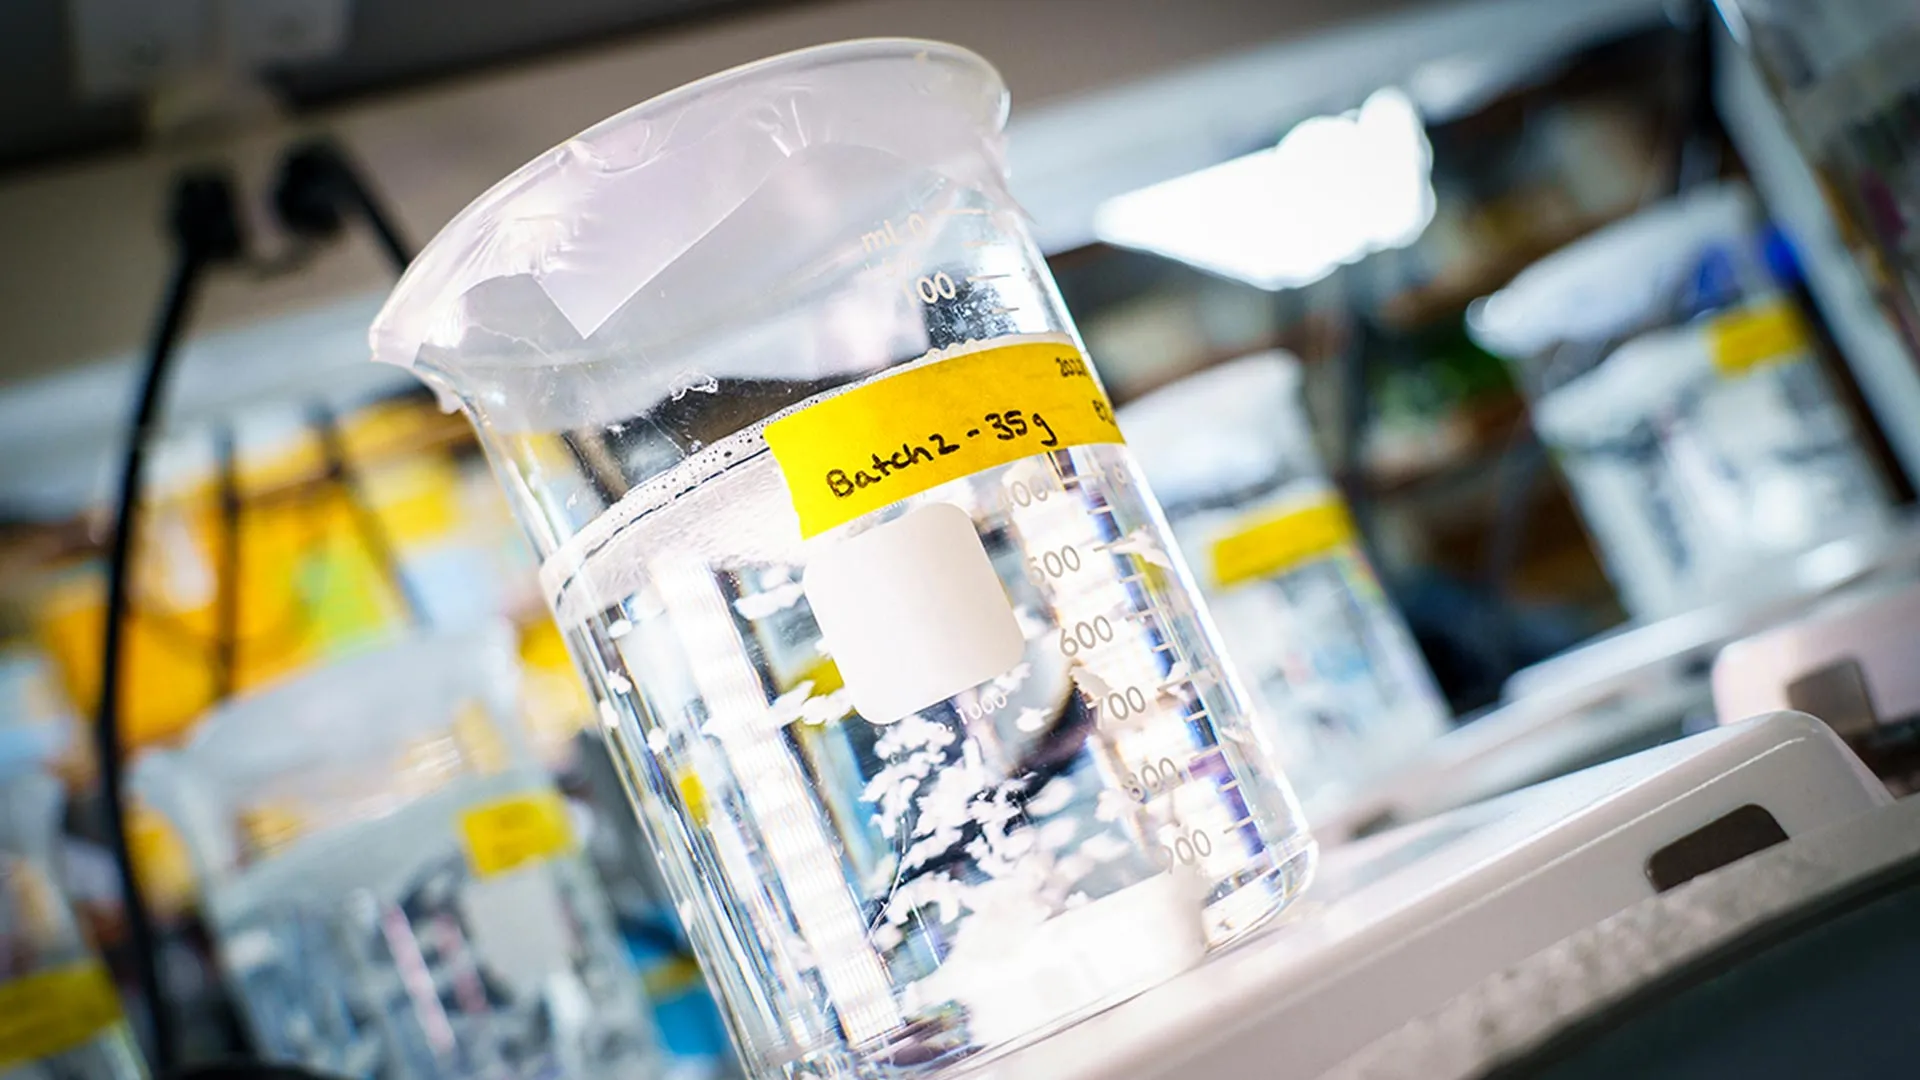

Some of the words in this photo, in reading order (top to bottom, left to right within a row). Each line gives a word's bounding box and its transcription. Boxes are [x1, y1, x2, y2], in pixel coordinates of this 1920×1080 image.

[902, 271, 956, 309] 100
[825, 443, 934, 498] Batch
[928, 433, 961, 455] 2
[1027, 544, 1081, 587] 500
[1058, 614, 1114, 657] 600
[955, 692, 1007, 725] 1000
[1085, 685, 1146, 730] 700
[1122, 756, 1178, 804] 800
[1155, 828, 1212, 875] 900
